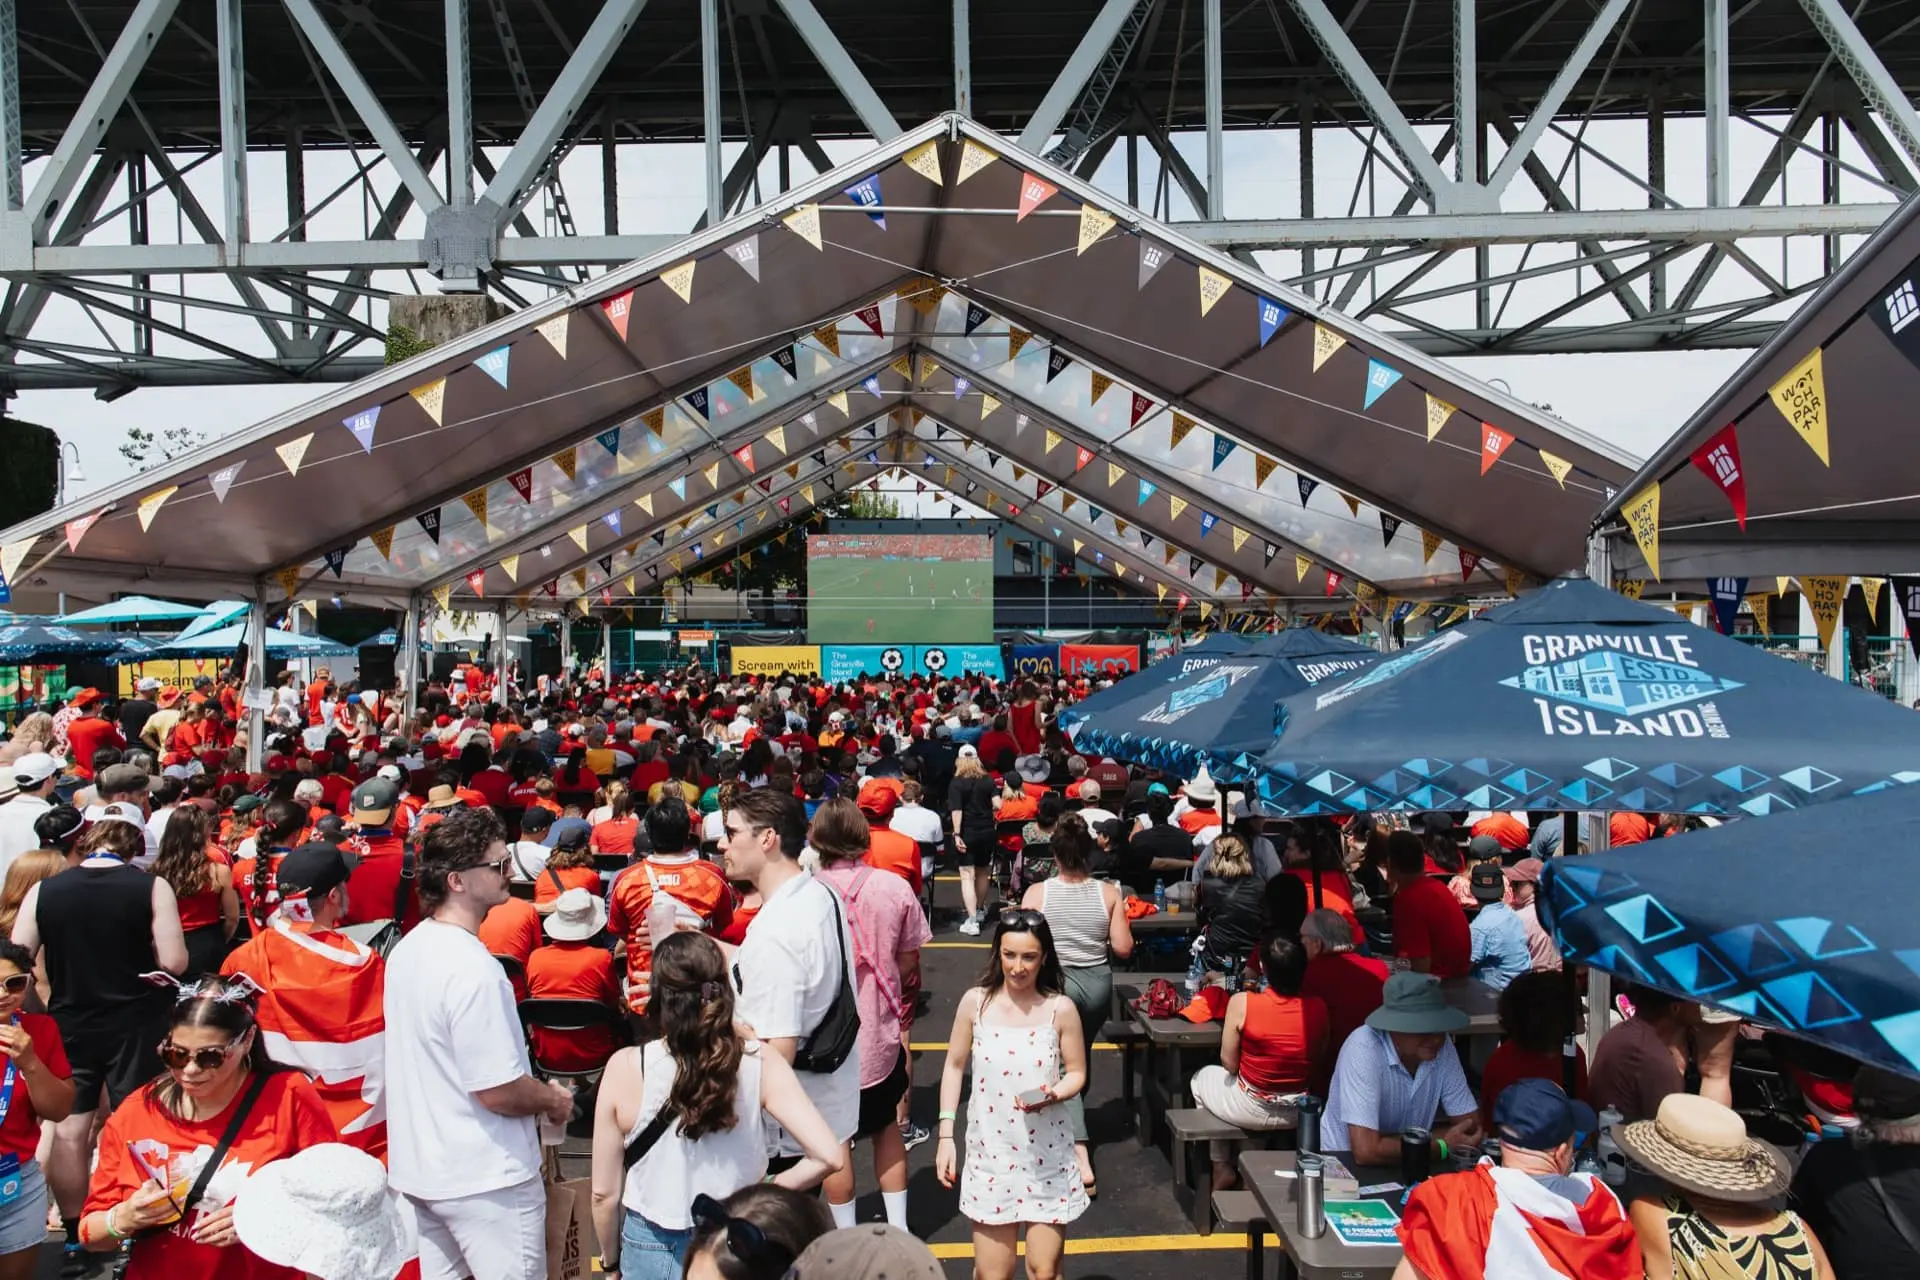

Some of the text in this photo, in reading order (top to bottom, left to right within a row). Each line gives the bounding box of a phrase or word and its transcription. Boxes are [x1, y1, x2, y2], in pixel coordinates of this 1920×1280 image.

[1793, 397, 1821, 423] PAR
[831, 651, 847, 660] The
[962, 651, 977, 660] The
[1523, 634, 1698, 667] GRANVILLE
[738, 659, 815, 671] Scream with
[1619, 657, 1698, 682] ESTD.
[1637, 682, 1699, 701] 1984
[1533, 698, 1704, 738] ISLAND
